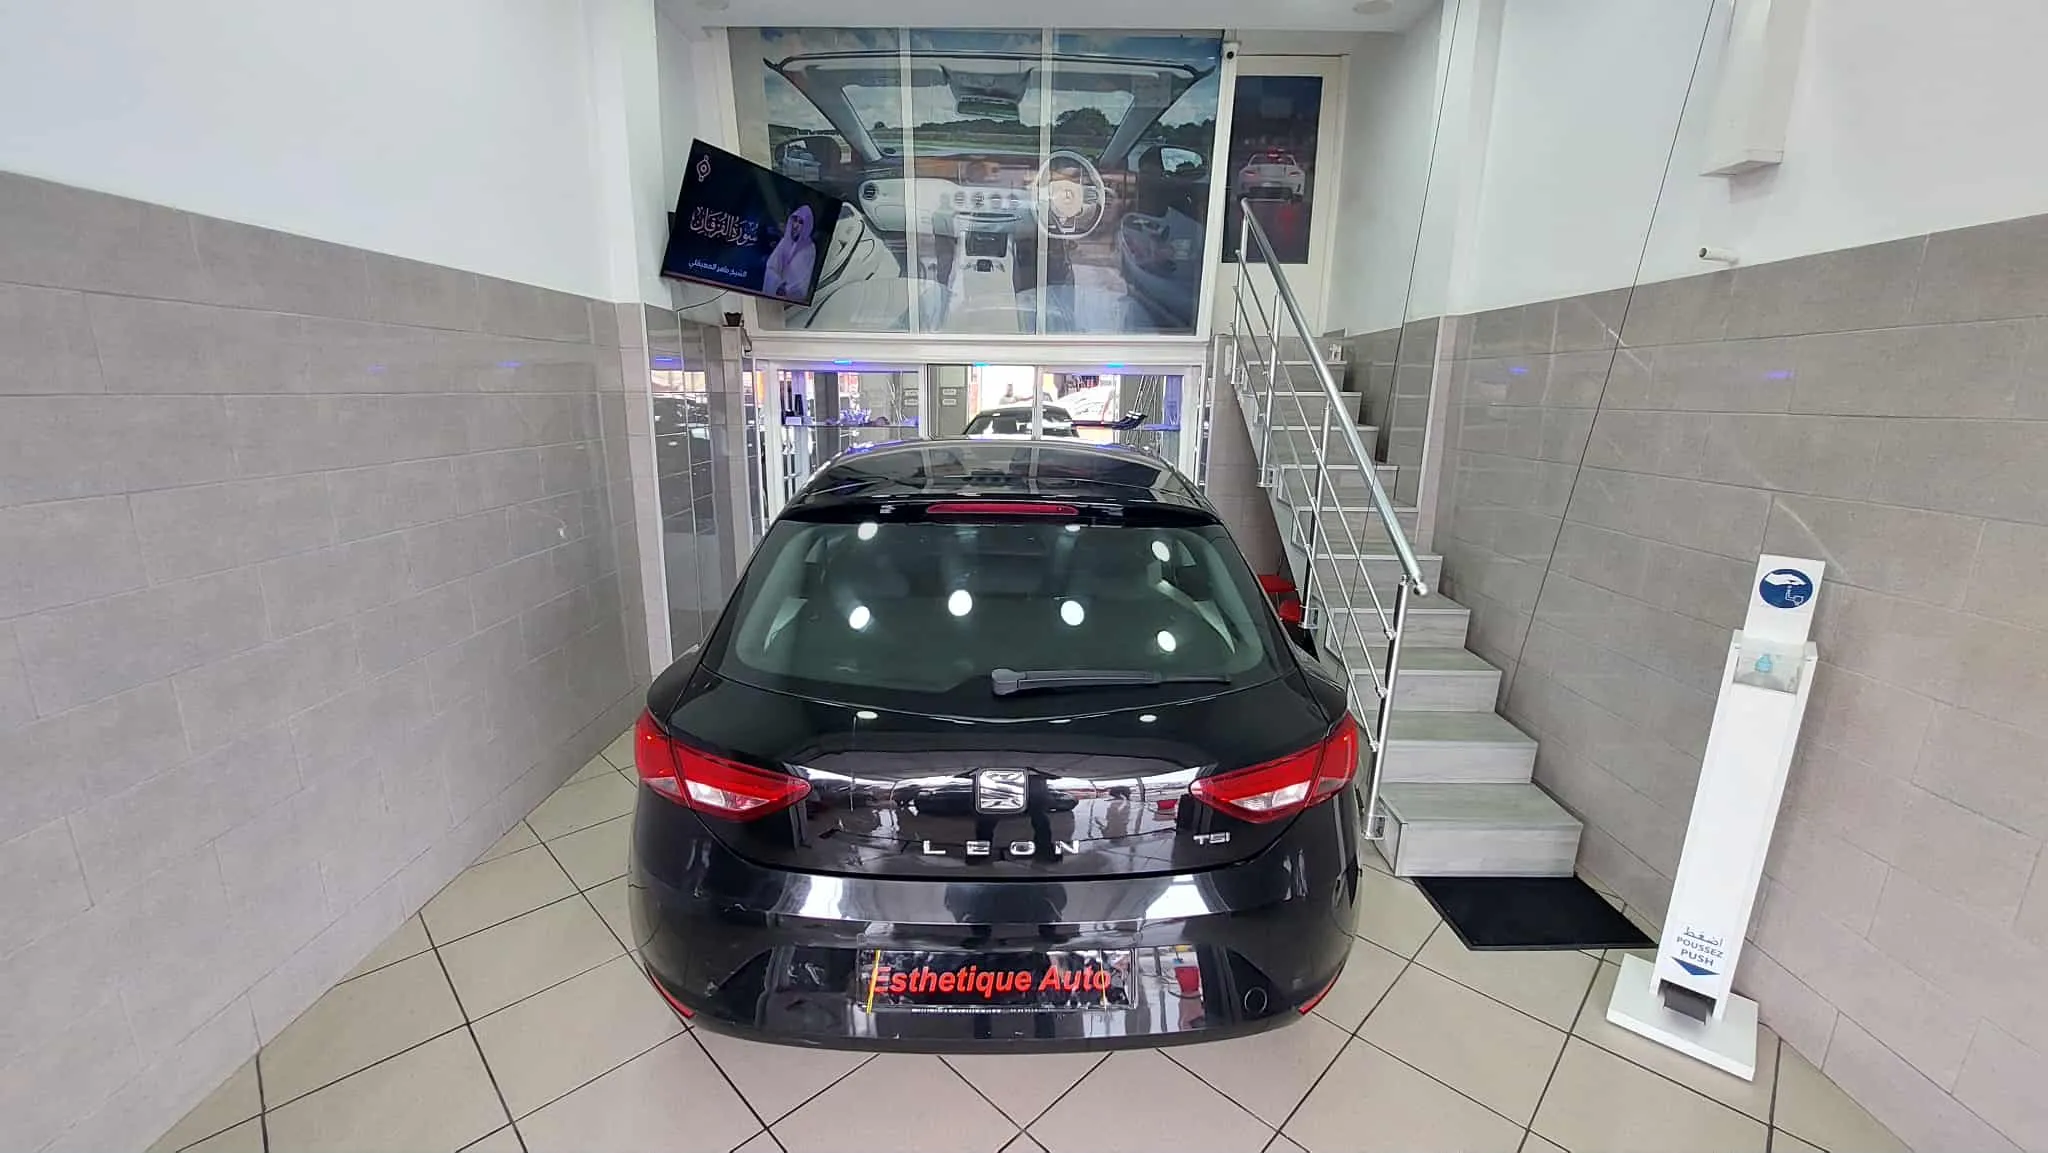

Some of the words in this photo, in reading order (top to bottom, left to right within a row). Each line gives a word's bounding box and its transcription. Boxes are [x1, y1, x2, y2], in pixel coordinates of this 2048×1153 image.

[922, 840, 1080, 856] LEON
[1193, 833, 1230, 845] TSI
[1683, 926, 1724, 947] اضغط
[1676, 936, 1724, 959] POUSSEZ
[1680, 948, 1714, 967] PUSH
[869, 965, 1032, 999] Esthetique
[1039, 965, 1112, 992] Auto
